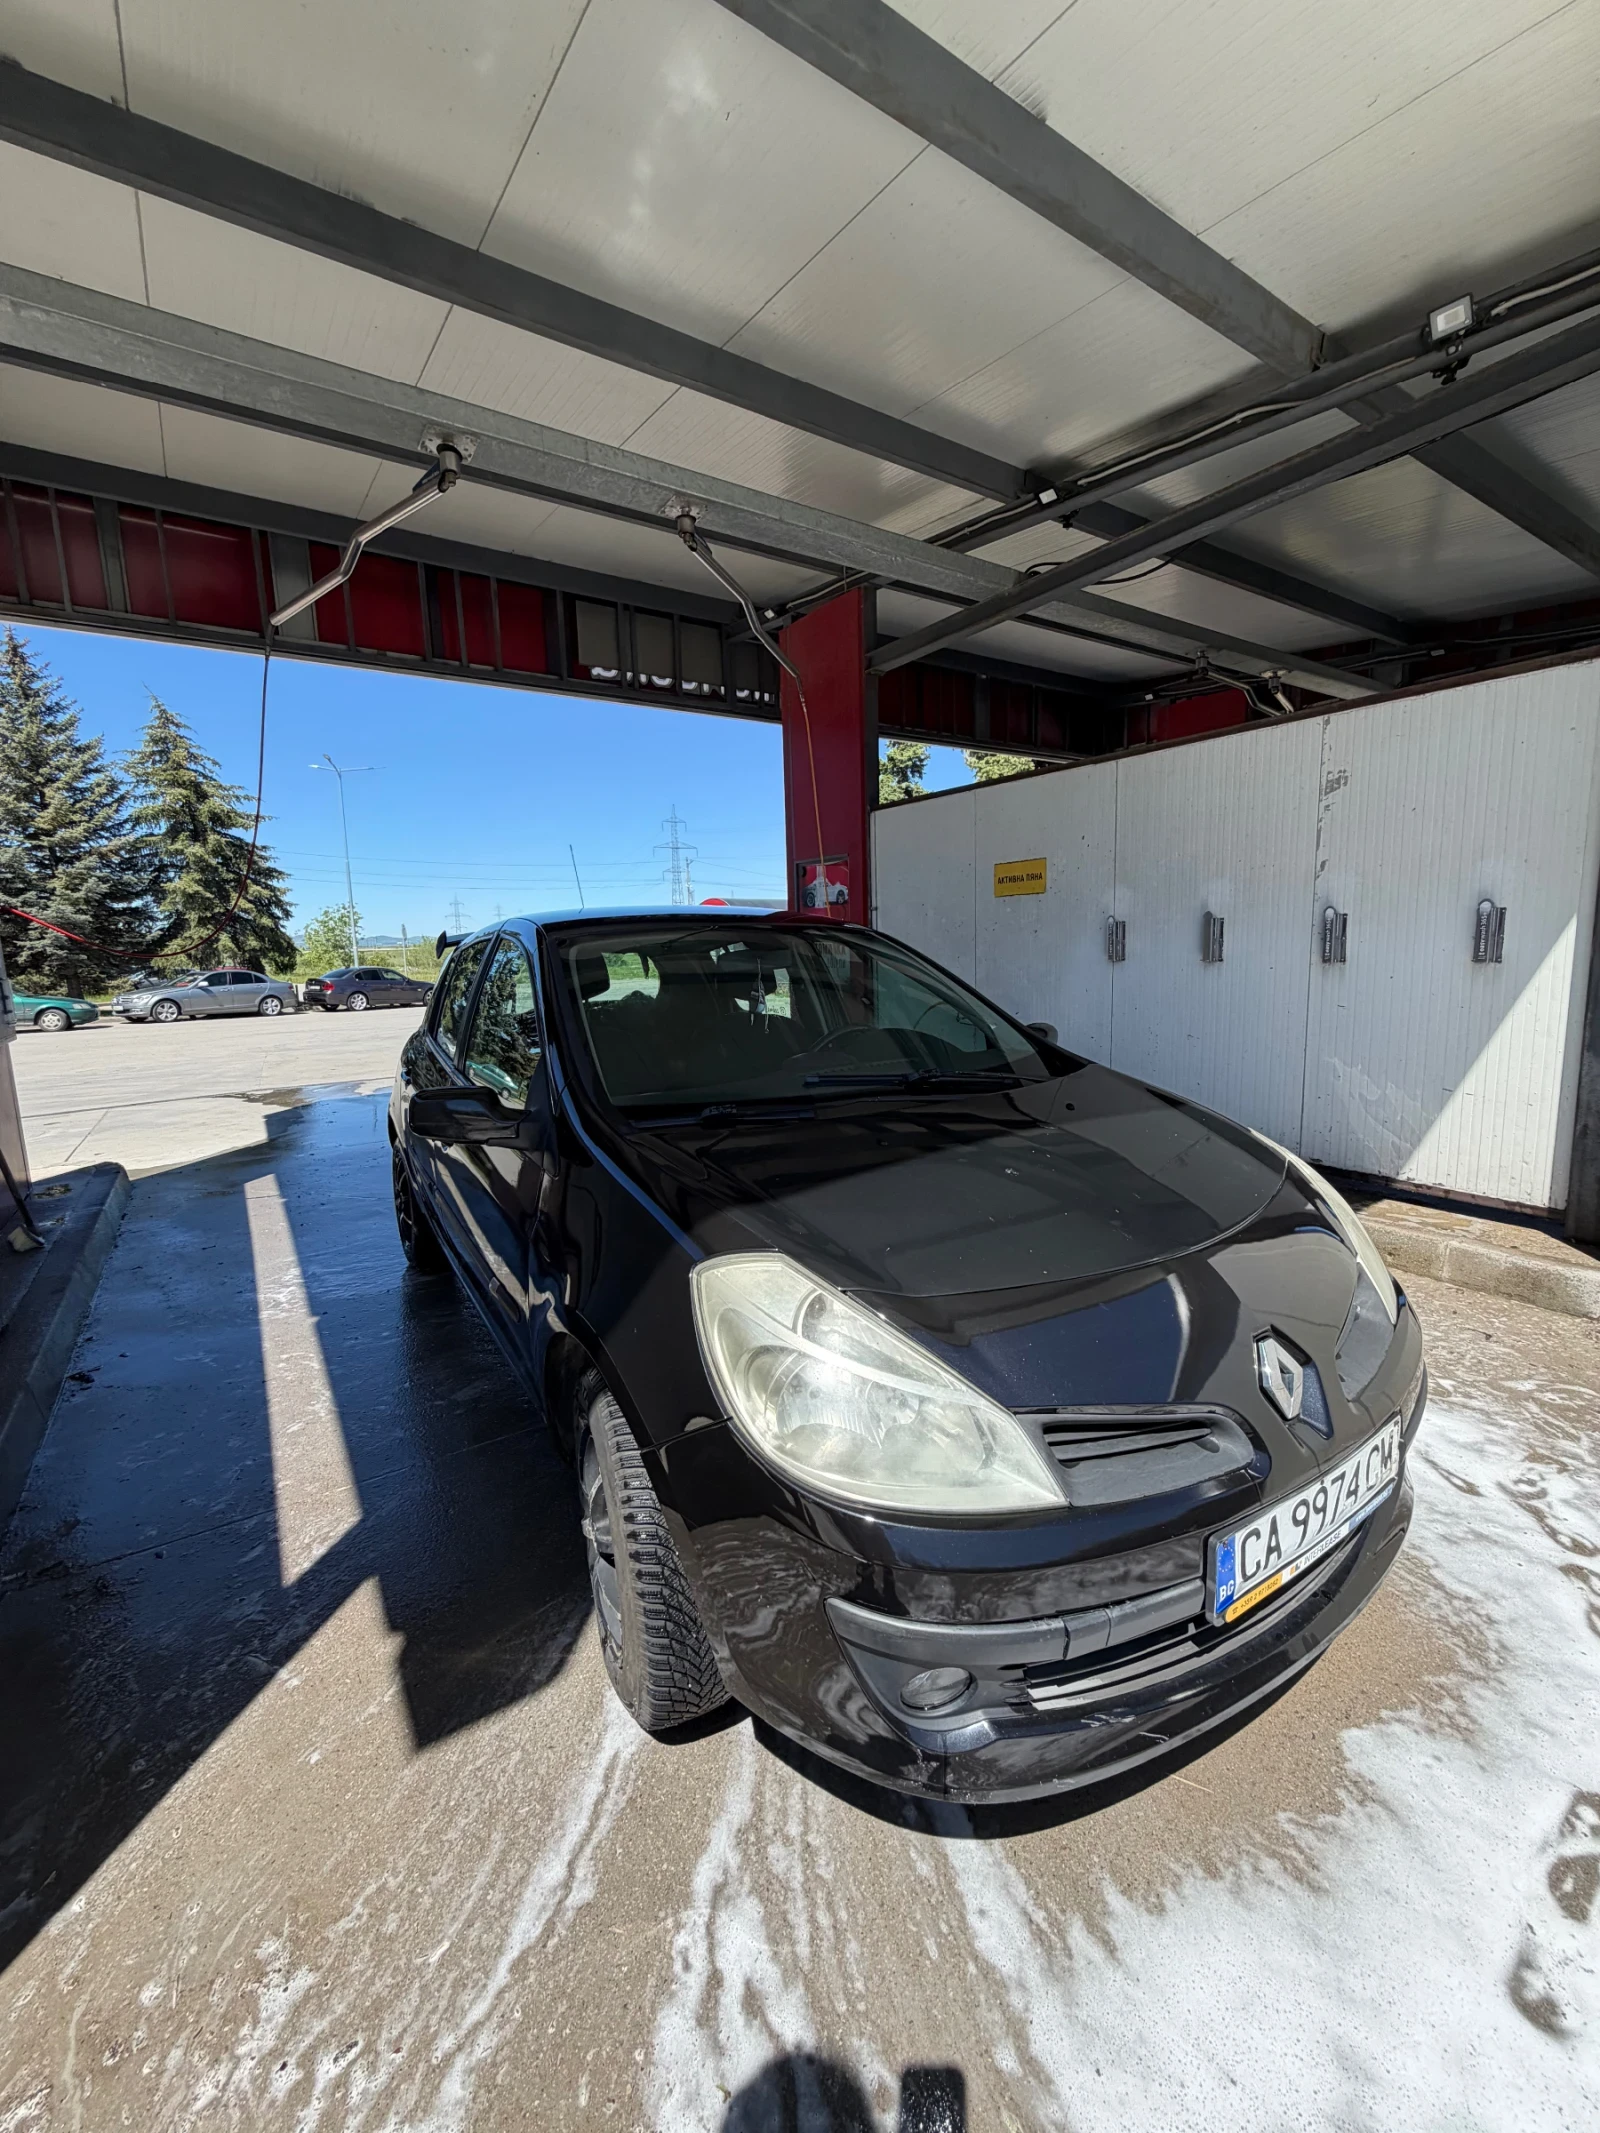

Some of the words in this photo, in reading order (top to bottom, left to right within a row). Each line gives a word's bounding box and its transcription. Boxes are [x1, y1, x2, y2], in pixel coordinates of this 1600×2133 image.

[998, 874, 1025, 884] АКТИВНА
[1240, 1514, 1282, 1583] CA
[1291, 1460, 1361, 1551] 9974
[1303, 1529, 1342, 1566] INTERLEASE
[1219, 1579, 1235, 1602] BG
